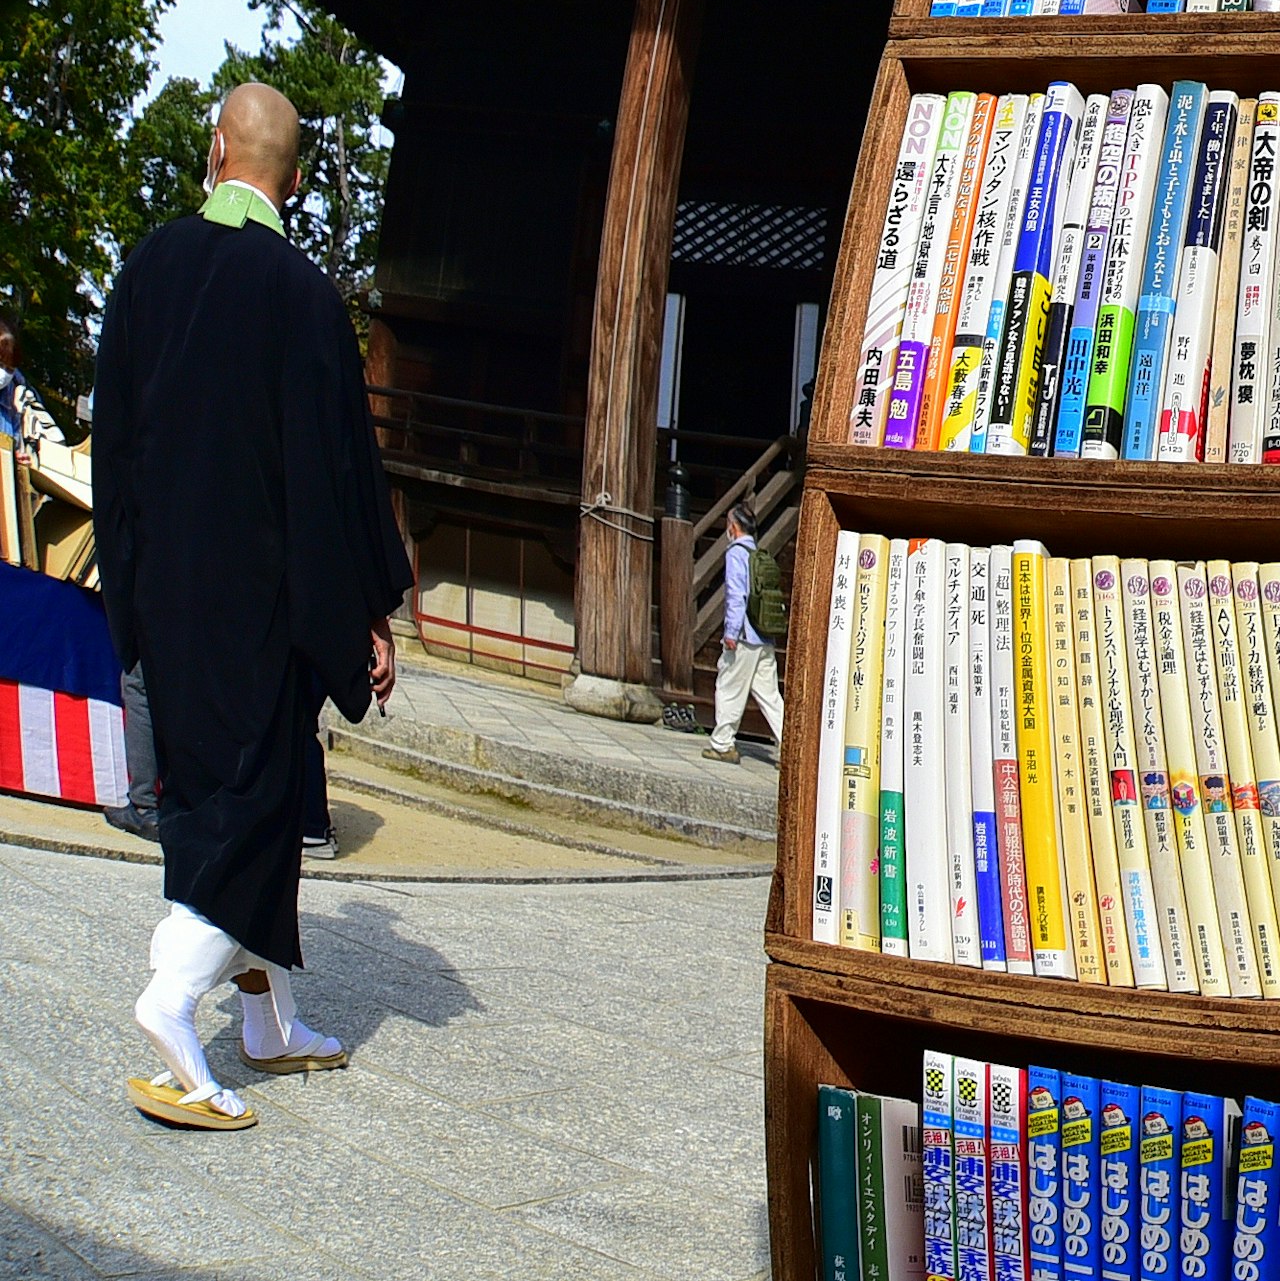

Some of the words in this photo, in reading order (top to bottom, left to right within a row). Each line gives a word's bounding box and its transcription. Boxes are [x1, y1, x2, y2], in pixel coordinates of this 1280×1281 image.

[906, 103, 933, 154] NON
[941, 96, 968, 148] NON
[878, 161, 914, 270] 還らざる道
[970, 130, 1012, 267] マンハッタン核作戦
[1025, 186, 1042, 231] 王女の男
[1112, 100, 1152, 259] 恐るべきTPPの正体
[1151, 94, 1192, 289] 泥と水と虫と子どもとおとなと
[1247, 131, 1276, 232] 大帝の剣
[888, 351, 916, 419] 五島勉
[948, 353, 969, 416] 大藪春彦
[999, 278, 1031, 417] 韓流ファンなら見逃せない!
[1062, 338, 1088, 416] 田中光二
[1095, 314, 1114, 374] 浜田和幸
[1136, 353, 1152, 403] 遠山洋一
[1237, 341, 1256, 404] 夢枕獏
[856, 348, 882, 428] 内田康夫
[832, 554, 851, 631] 対象喪失
[911, 561, 927, 676] 落下傘学長奮闘記
[948, 557, 960, 646] マルチメディア
[971, 561, 986, 627] 交通死
[995, 566, 1011, 652] 「超」整理法
[1018, 560, 1036, 731] 日本は世界1位の金属資源大国
[1054, 584, 1070, 707] 品質管理の知識
[1103, 604, 1127, 767] トランスパーソナル心理学入門
[1131, 608, 1159, 747] 経済学はむずかしくない
[884, 809, 897, 879] 岩波新書
[861, 1112, 878, 1251] オンリィ・イエスタデイ
